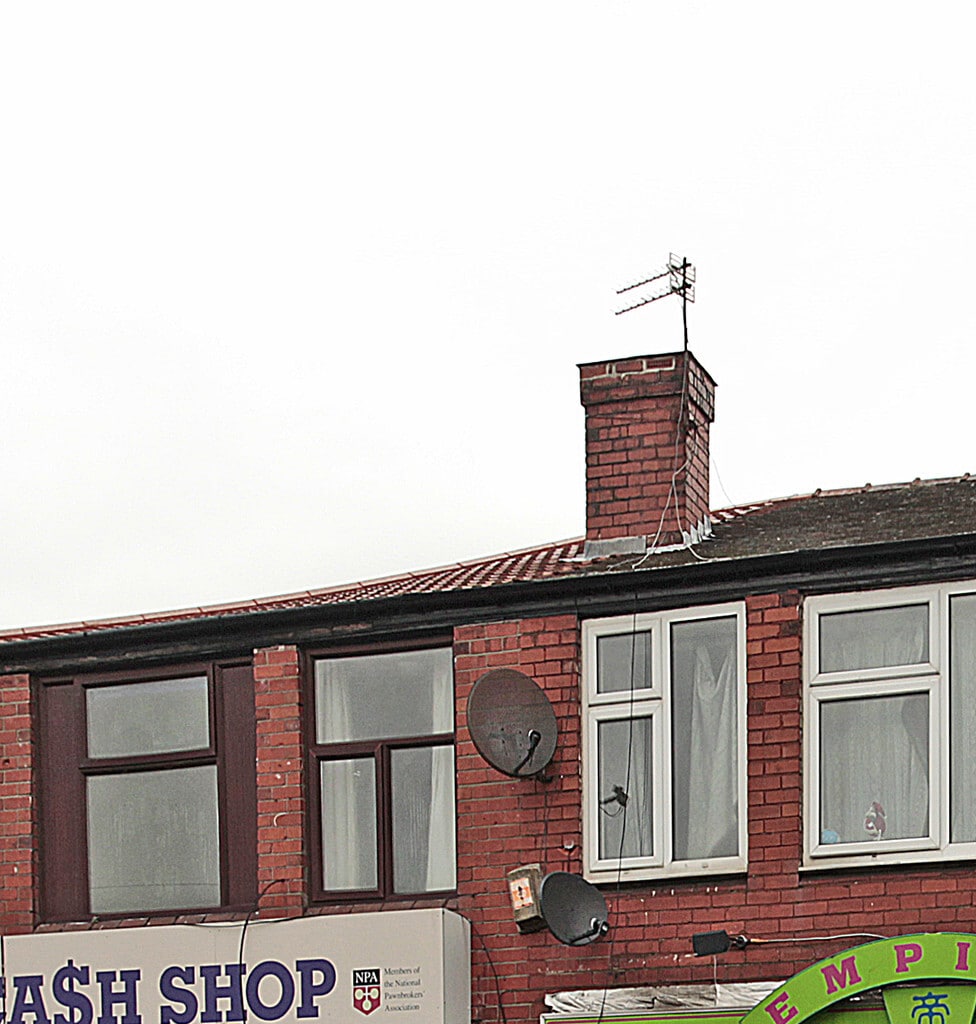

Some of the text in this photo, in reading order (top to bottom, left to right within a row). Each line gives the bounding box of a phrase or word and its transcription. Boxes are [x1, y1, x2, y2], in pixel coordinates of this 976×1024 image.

[355, 971, 378, 984] NPA
[395, 978, 421, 987] National
[384, 1004, 420, 1012] Association
